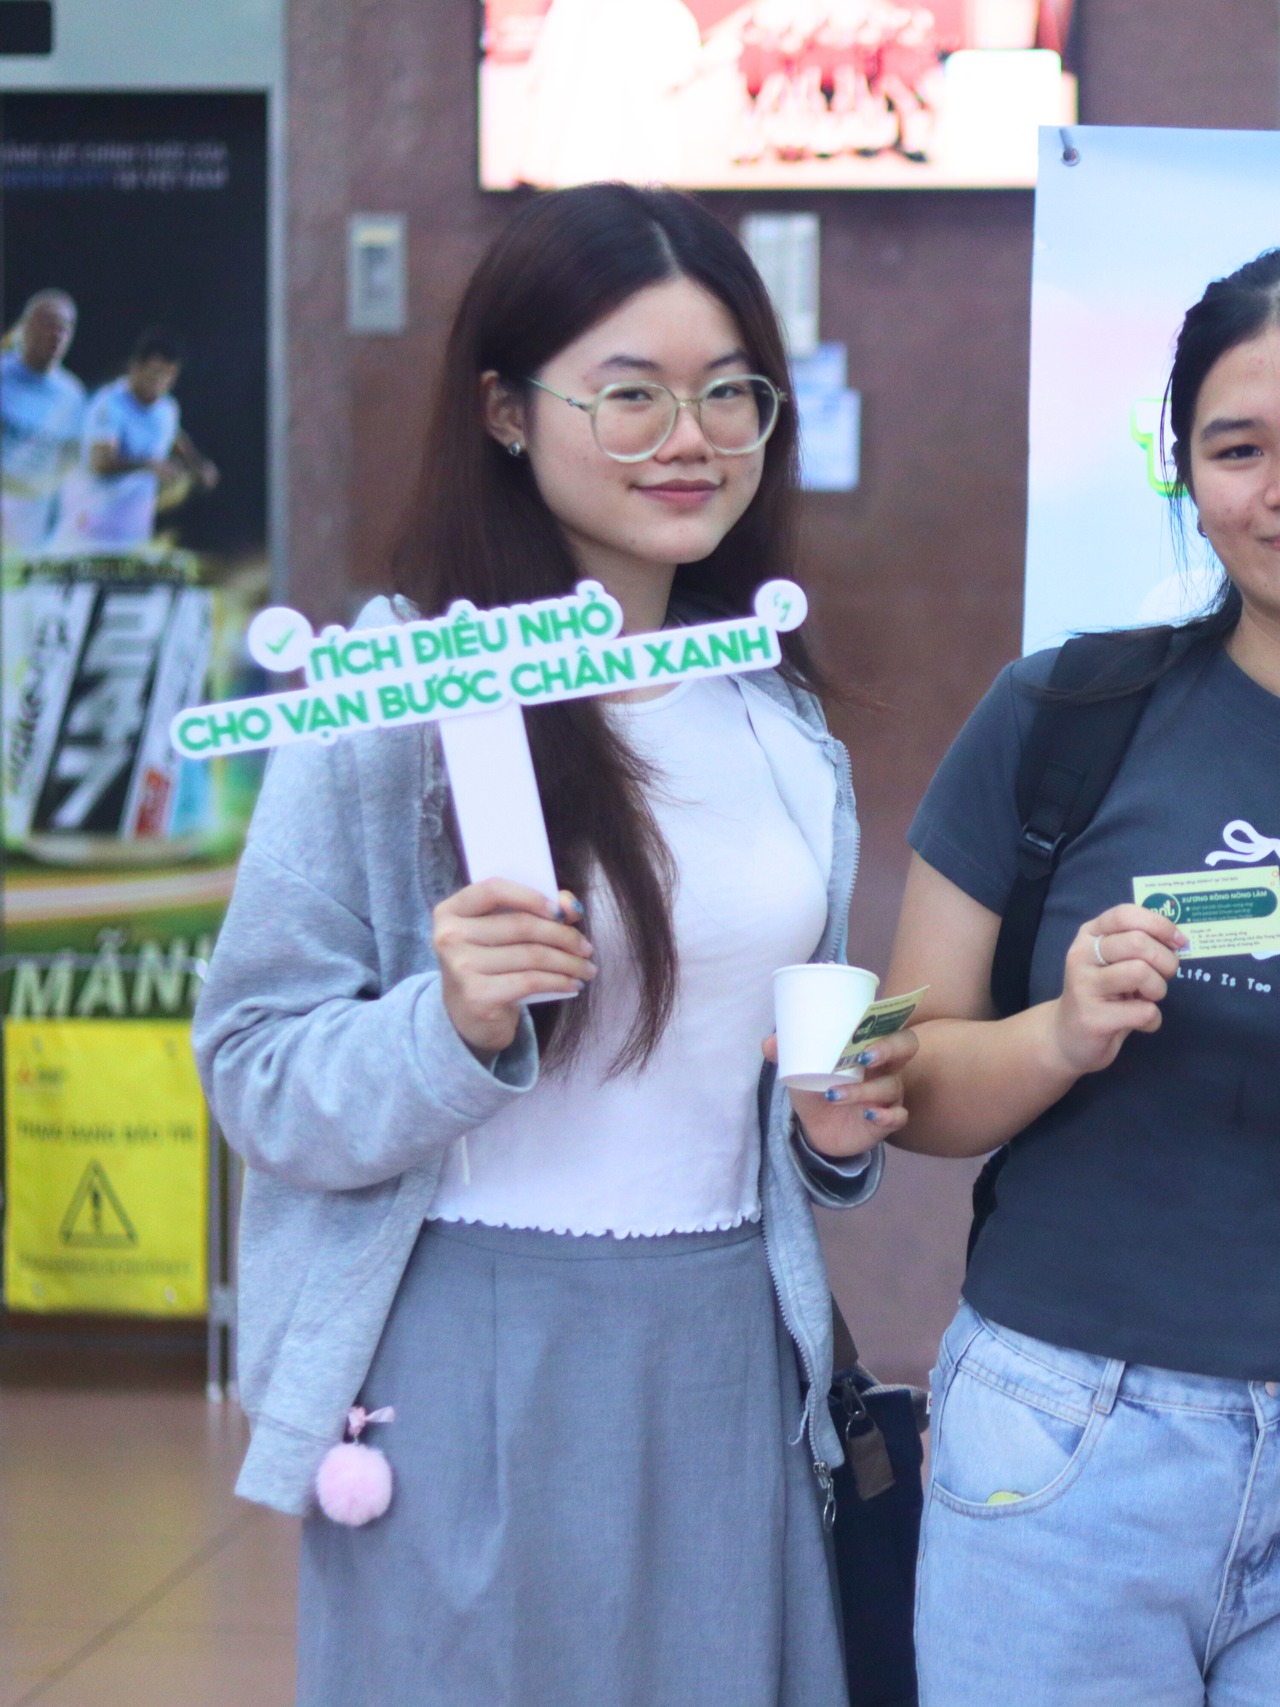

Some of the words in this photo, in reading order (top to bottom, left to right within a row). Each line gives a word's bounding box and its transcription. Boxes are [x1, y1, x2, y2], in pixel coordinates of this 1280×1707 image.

[411, 609, 509, 665] ĐIỀU
[518, 589, 614, 647] NHỎ
[178, 706, 272, 751] CHO
[277, 690, 371, 739] VẠN
[377, 665, 502, 720] BƯỚC
[510, 645, 637, 697] CHÂN
[644, 626, 772, 677] XANH
[1221, 973, 1237, 987] Is
[1248, 978, 1272, 993] Too
